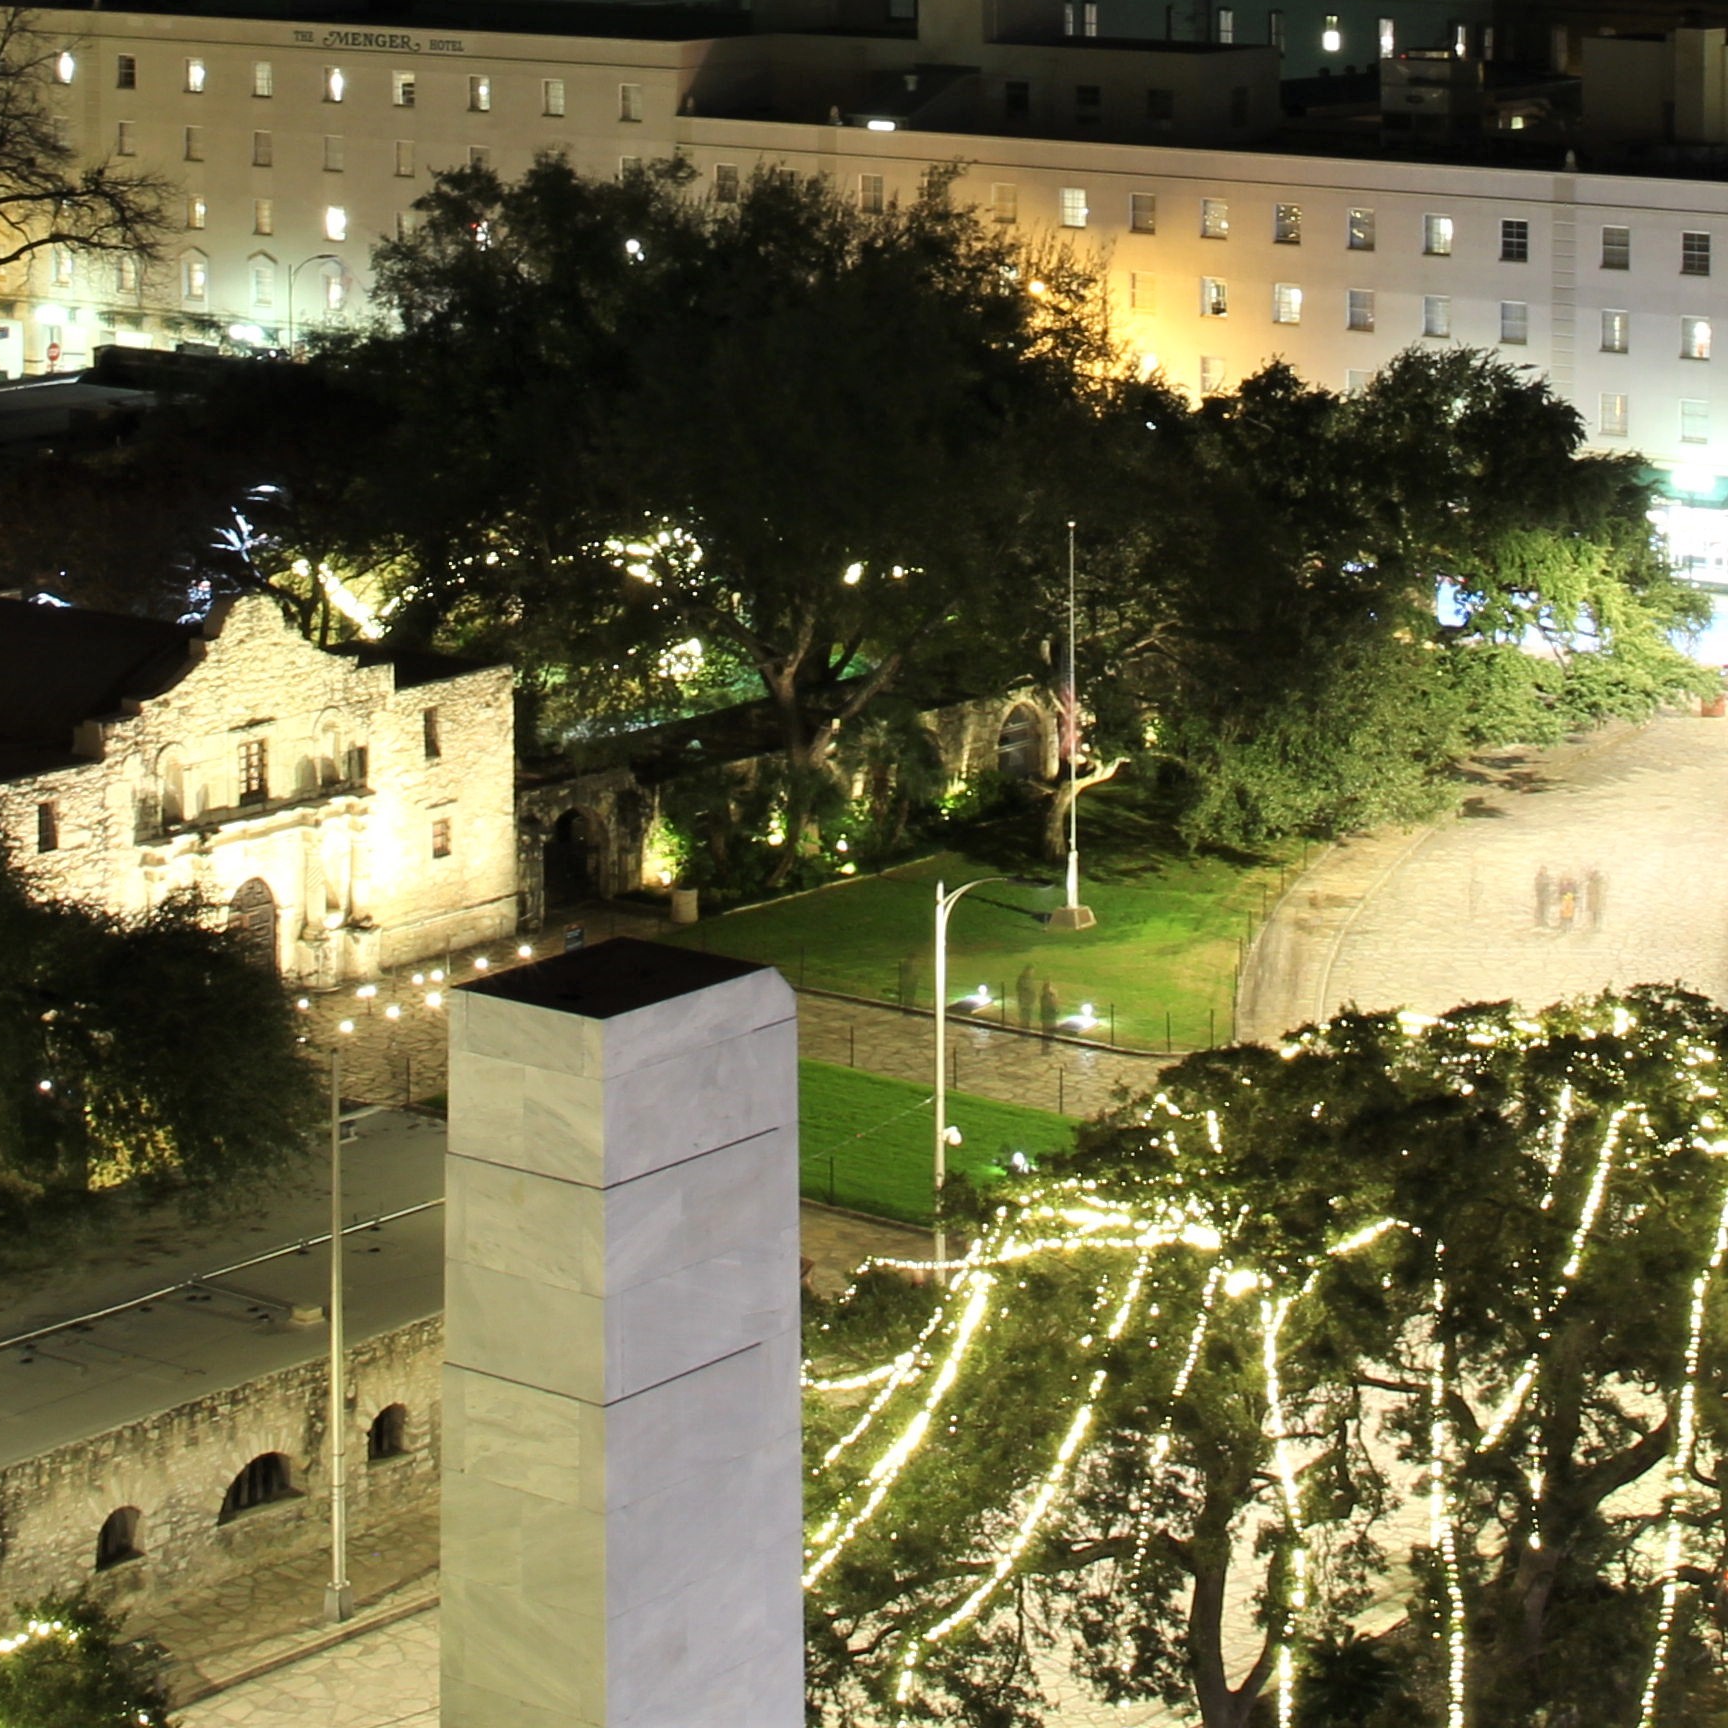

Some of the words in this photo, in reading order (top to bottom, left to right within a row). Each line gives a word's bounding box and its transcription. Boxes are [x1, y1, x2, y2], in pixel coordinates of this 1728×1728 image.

[292, 30, 314, 43] THE
[323, 31, 421, 52] MENGER
[429, 39, 465, 52] HOTEL
